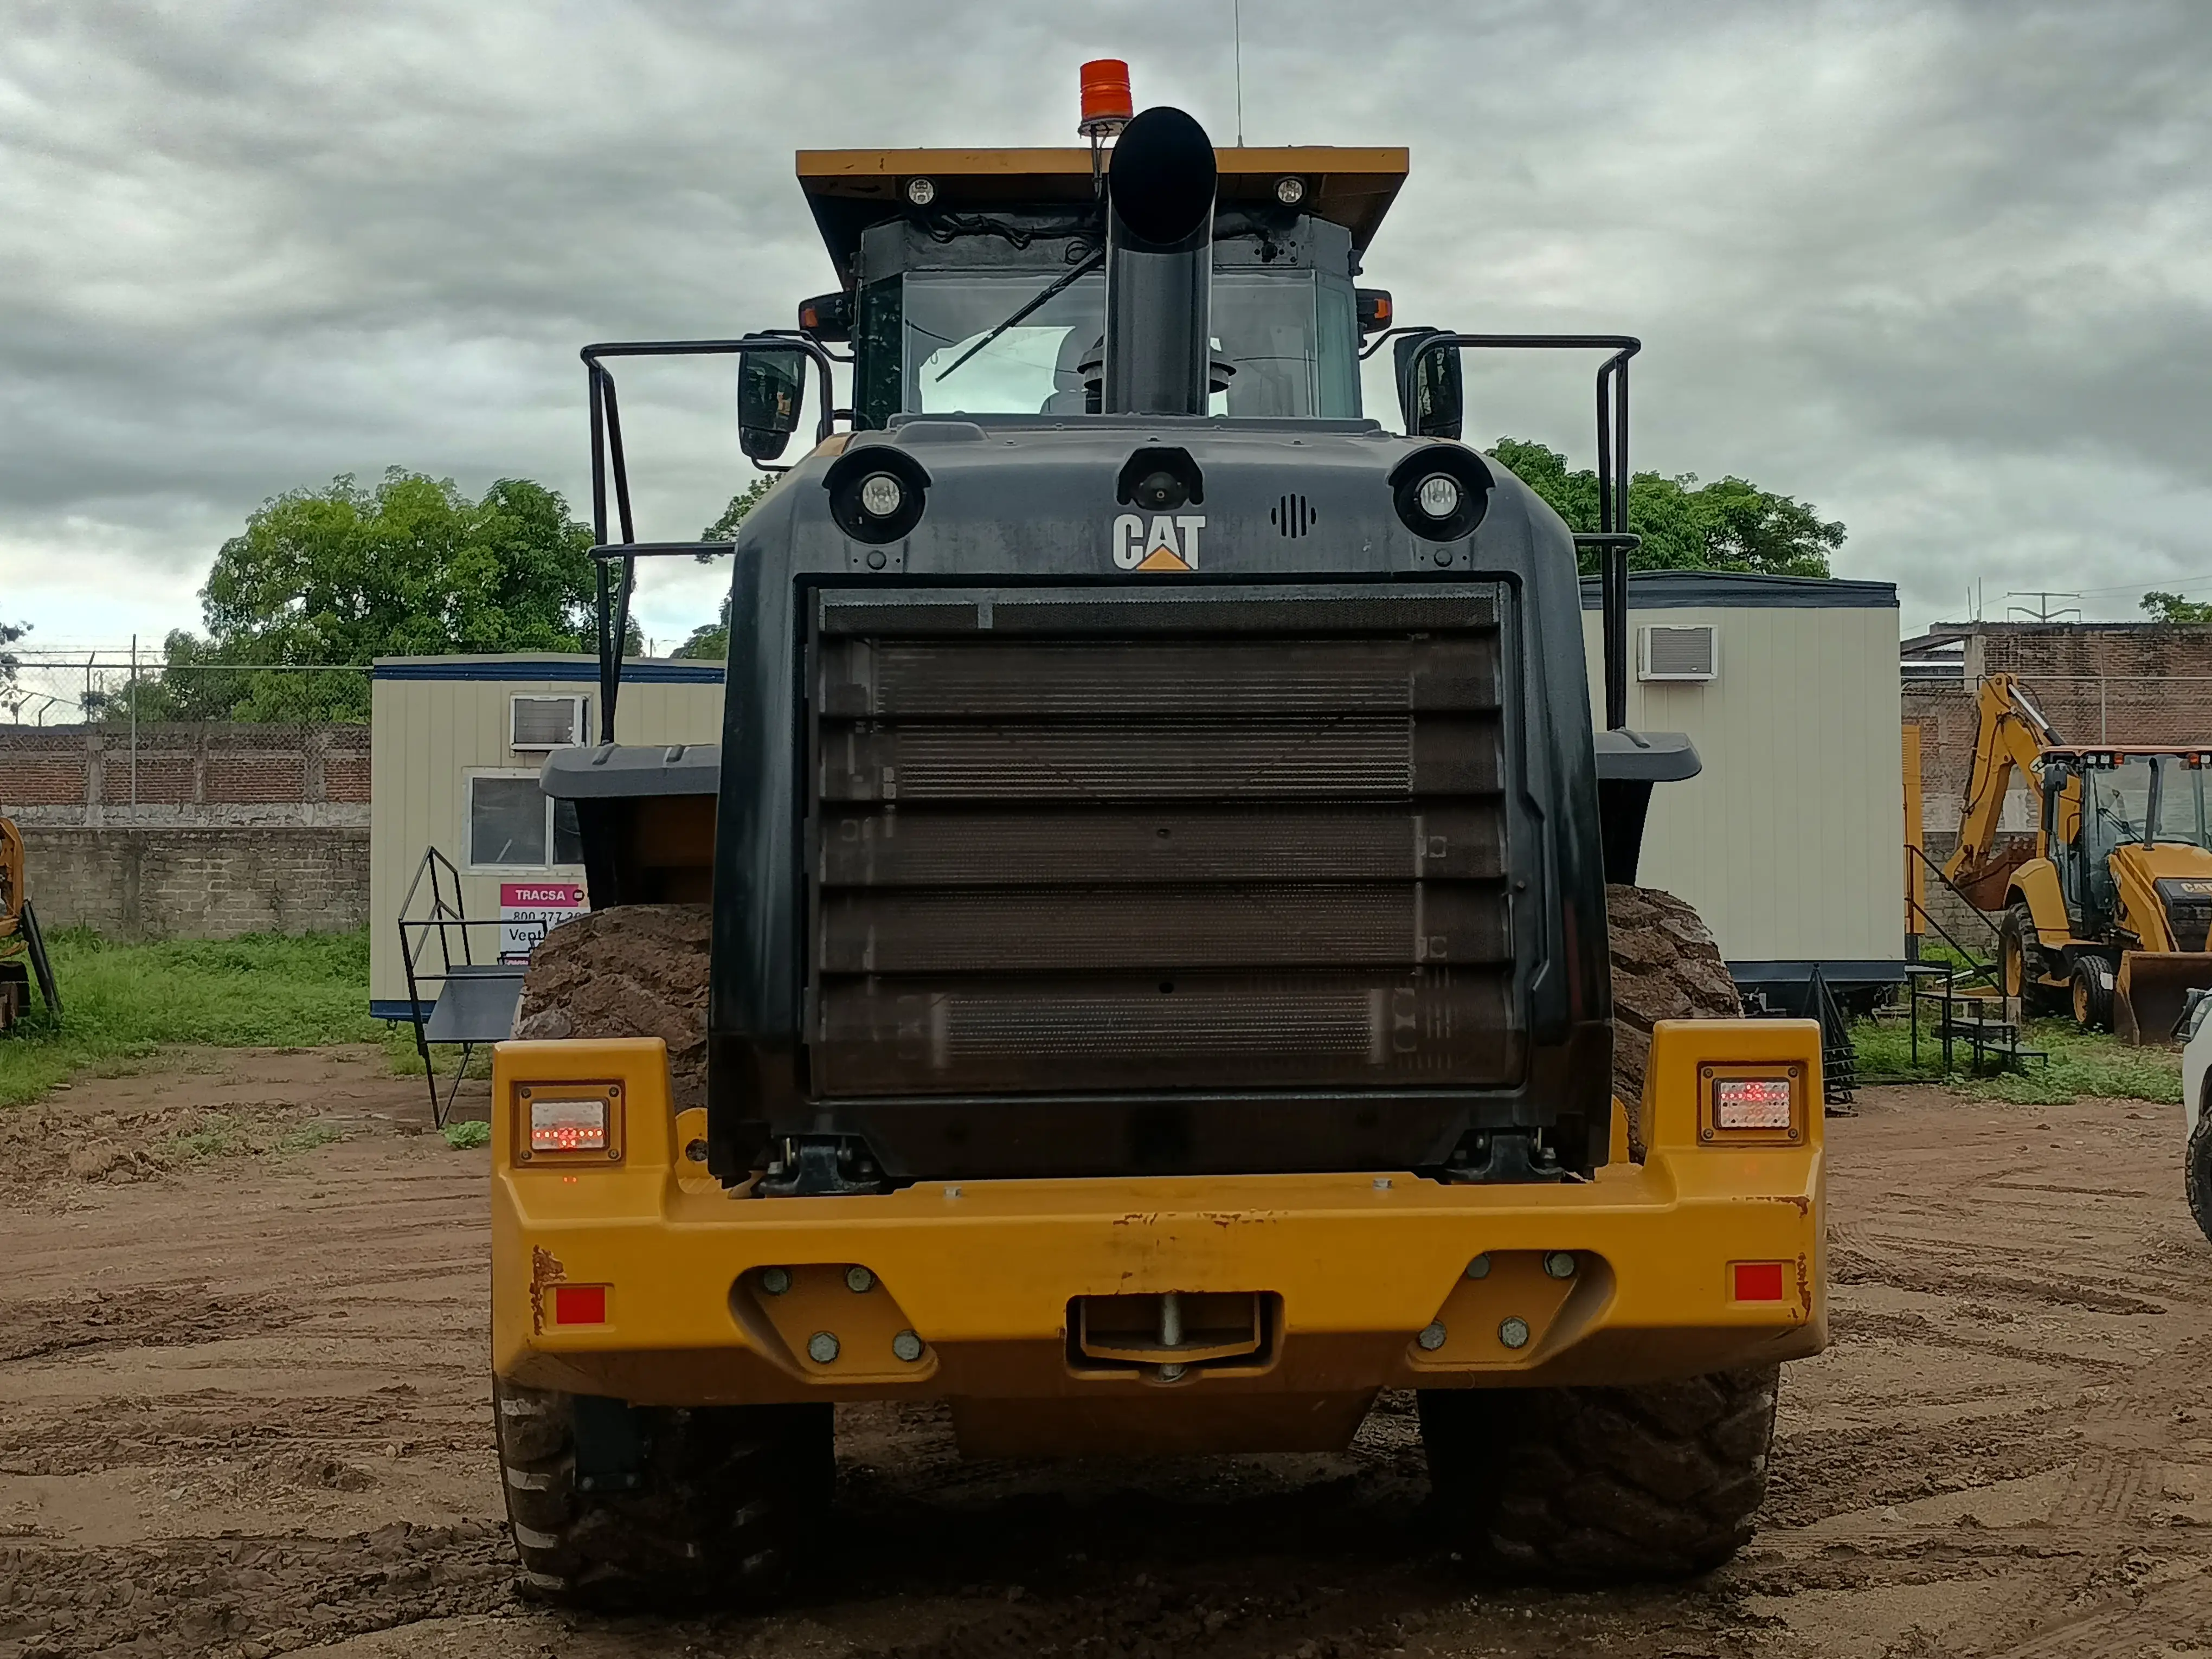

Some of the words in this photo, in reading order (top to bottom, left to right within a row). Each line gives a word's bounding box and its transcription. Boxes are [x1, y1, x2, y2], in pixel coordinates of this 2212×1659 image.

[1113, 514, 1206, 570] CAT
[516, 890, 565, 901] TRACSA
[509, 929, 545, 941] Vent
